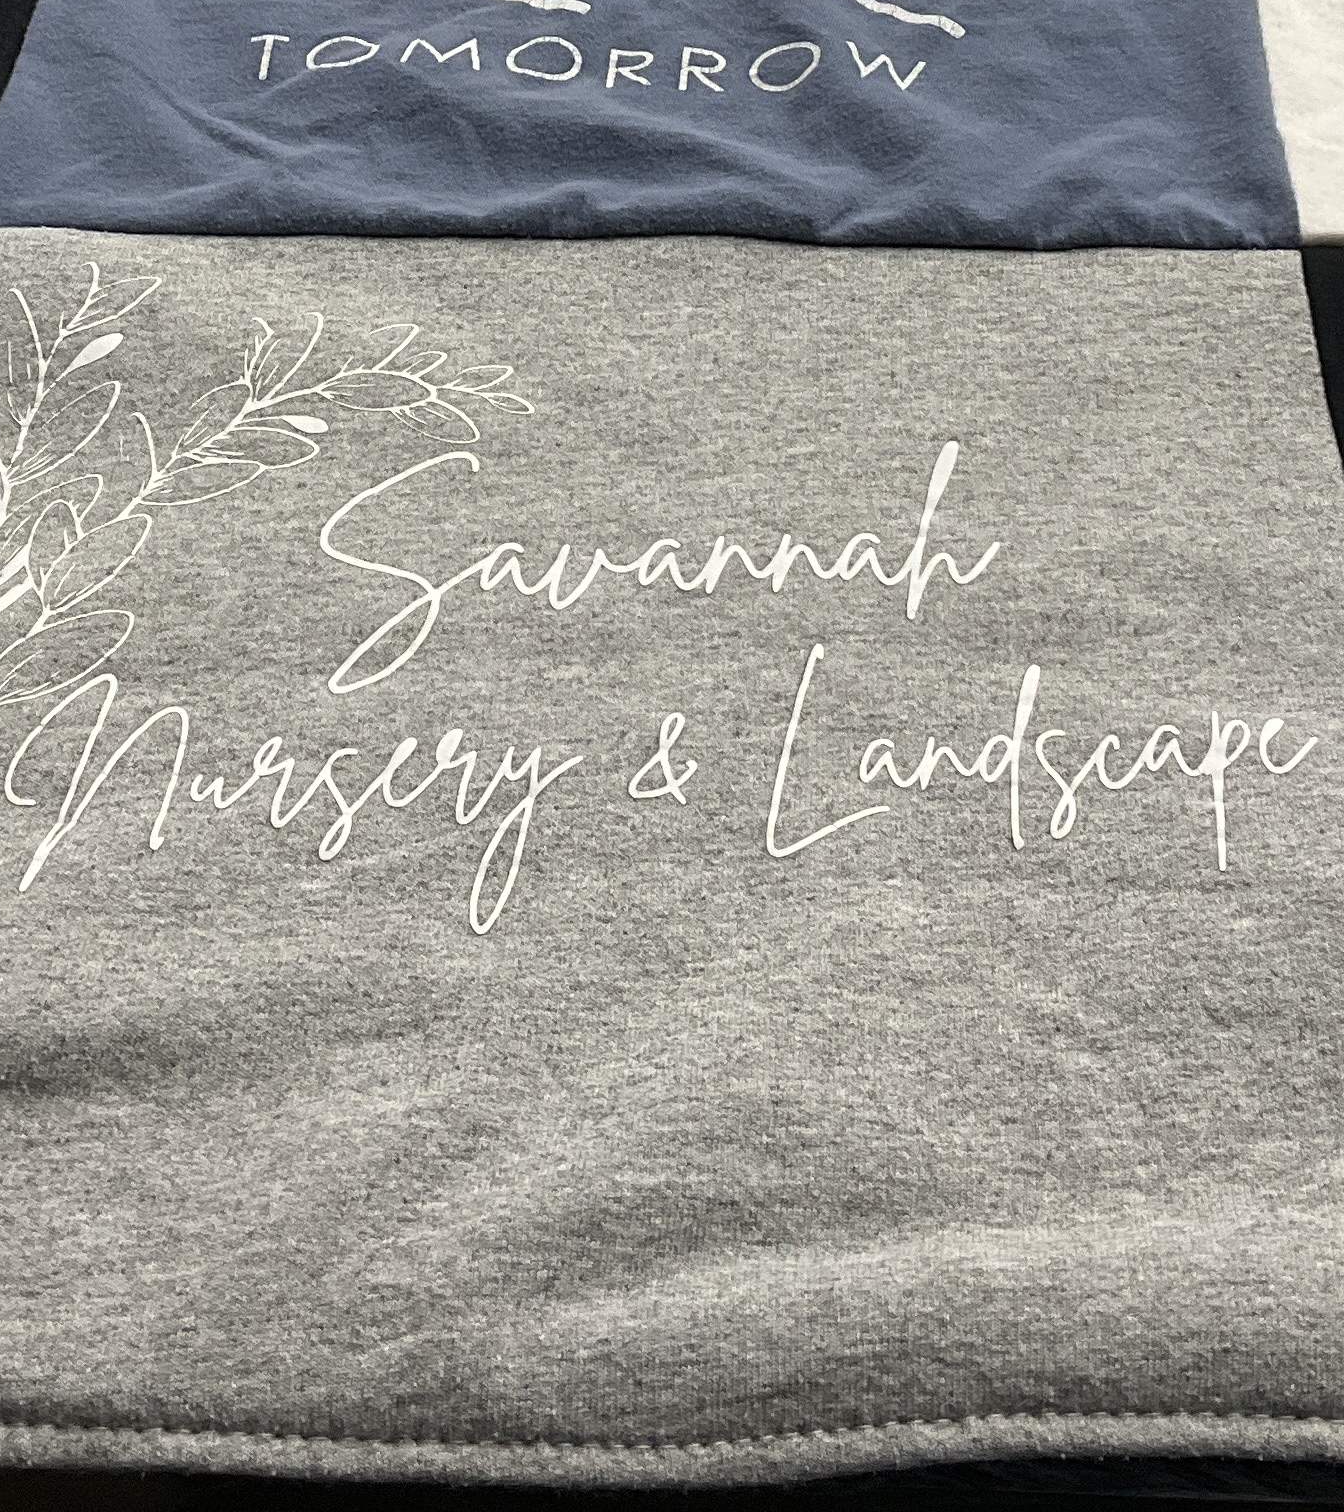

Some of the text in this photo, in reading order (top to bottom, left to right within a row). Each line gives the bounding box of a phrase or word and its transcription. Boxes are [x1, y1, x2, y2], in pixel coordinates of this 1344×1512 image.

[248, 34, 929, 94] TOMORROW
[319, 440, 1001, 695] Savannah
[5, 643, 1320, 935] Nursery & Landscape
